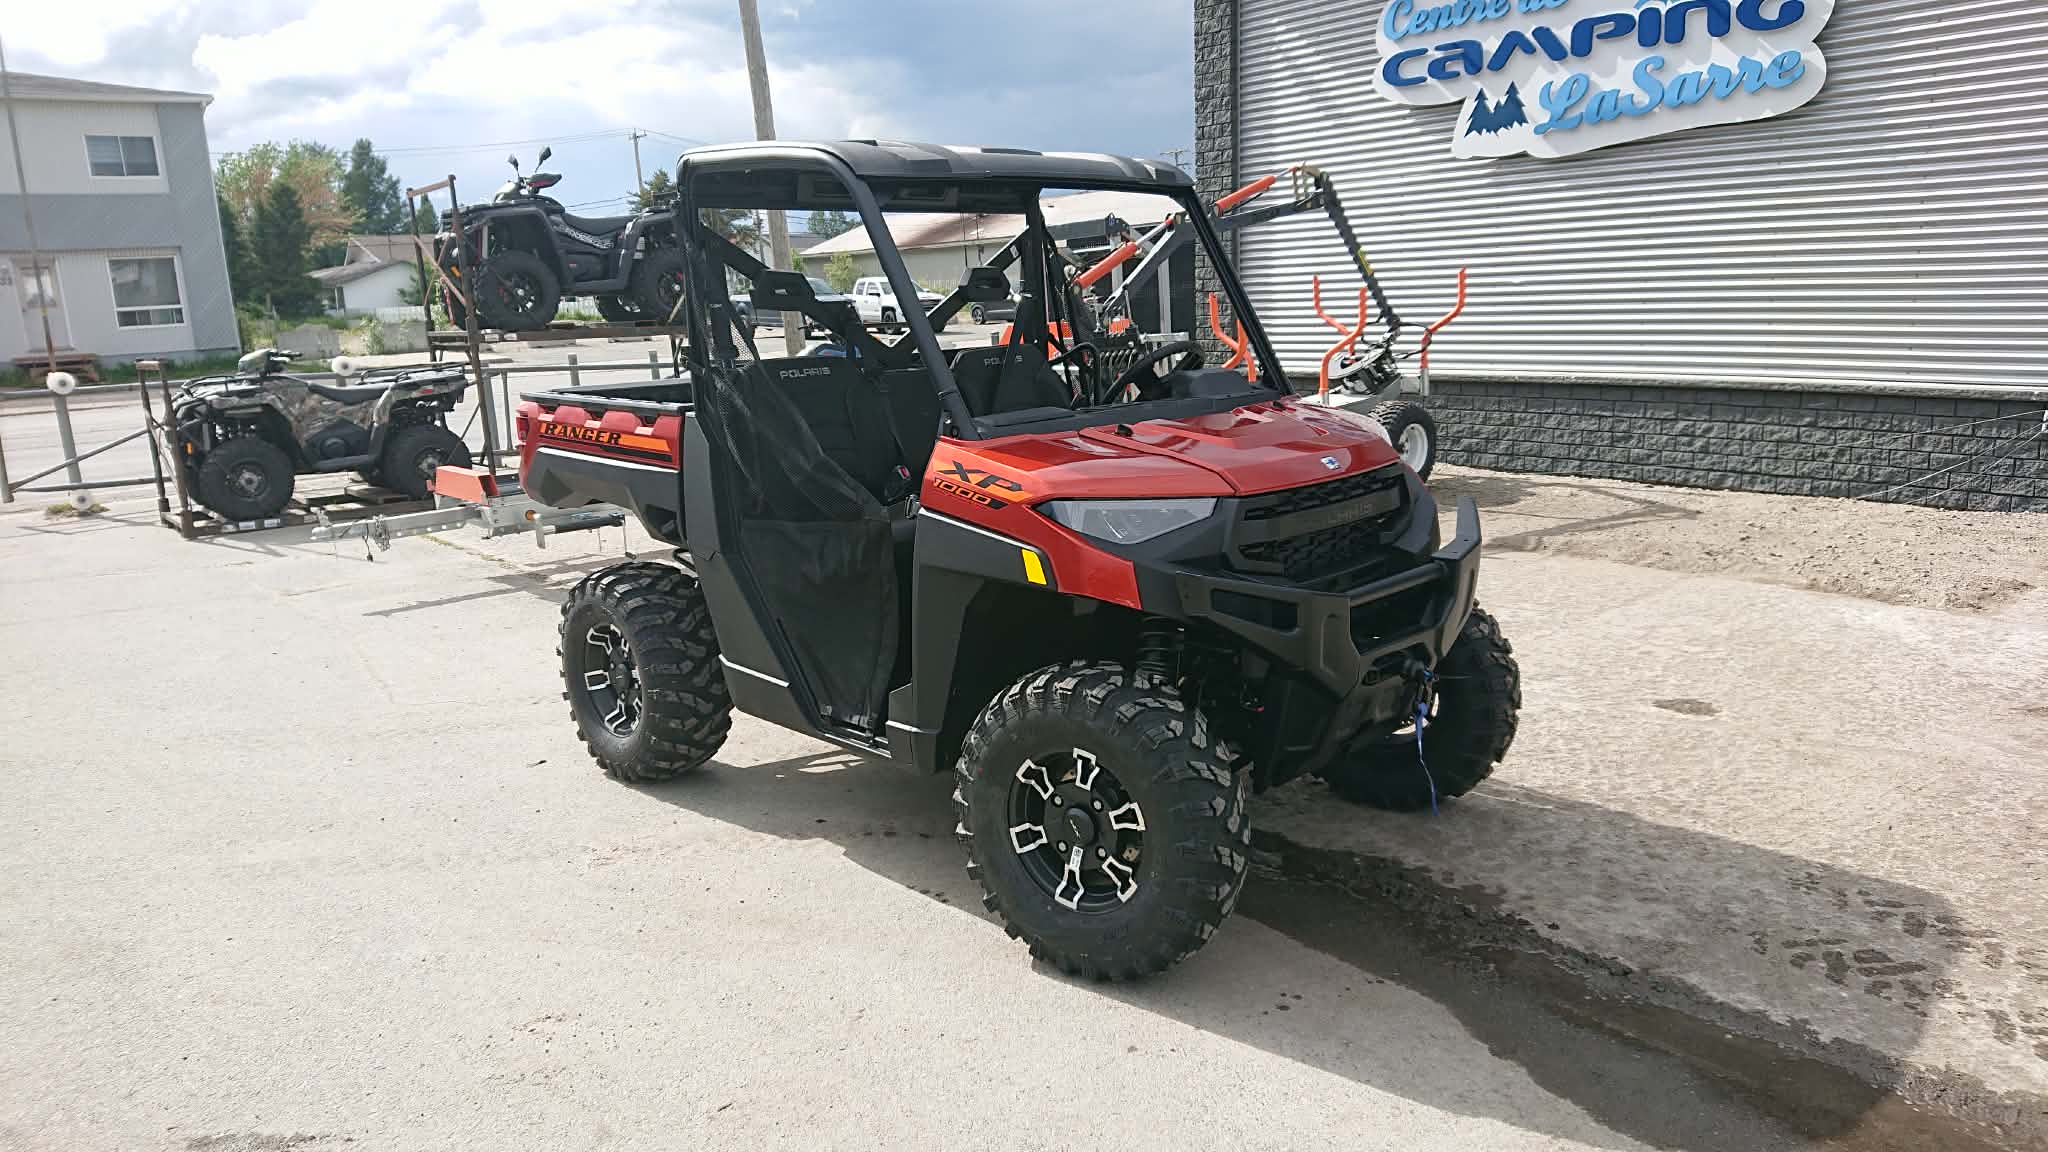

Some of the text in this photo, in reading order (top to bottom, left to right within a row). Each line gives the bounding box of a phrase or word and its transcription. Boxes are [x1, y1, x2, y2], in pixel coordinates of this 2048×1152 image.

[1384, 0, 1511, 40] Centre
[1533, 50, 1805, 134] LaSarre
[779, 367, 832, 380] POLARIS
[543, 423, 622, 445] RANGER
[938, 460, 1024, 492] XP
[933, 478, 992, 506] 1000
